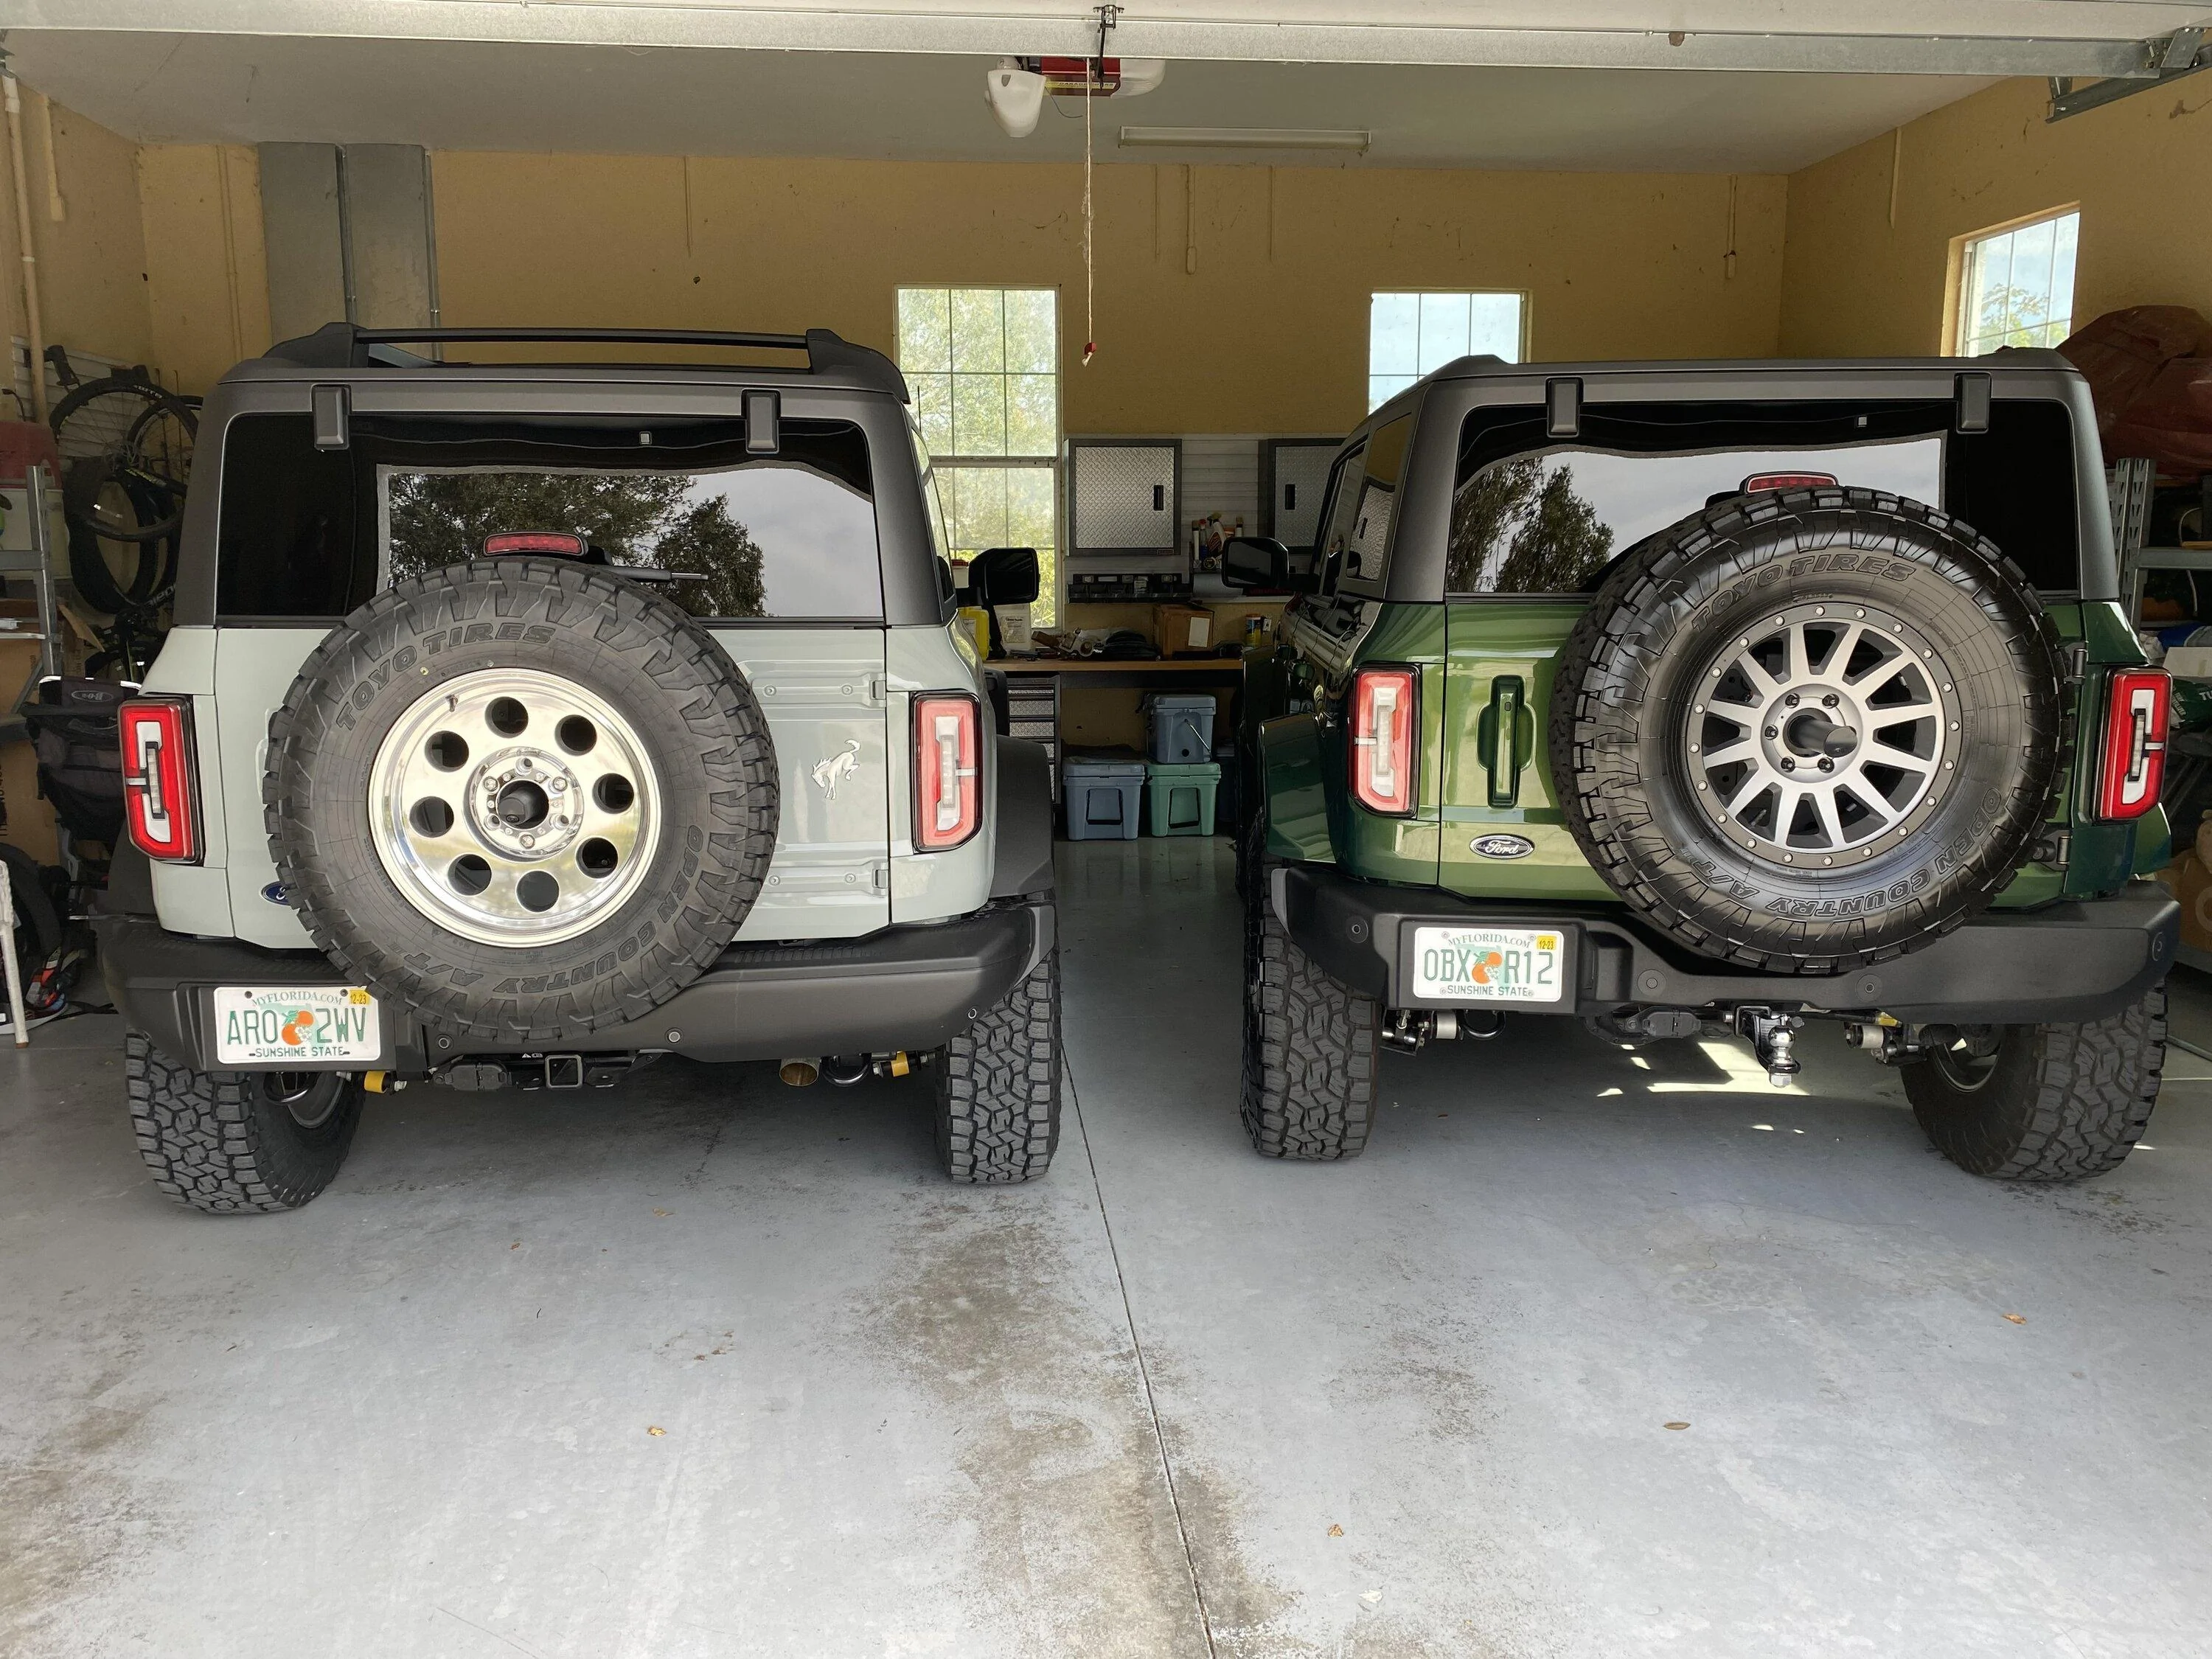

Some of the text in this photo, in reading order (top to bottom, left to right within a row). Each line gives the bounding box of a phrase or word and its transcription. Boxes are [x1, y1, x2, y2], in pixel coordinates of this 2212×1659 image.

[1691, 554, 1917, 633] TOYO TIRES
[335, 622, 555, 731] TOYO TIRES
[1484, 839, 1520, 854] Ford
[1935, 787, 2002, 875] OPEN
[657, 824, 703, 923] OPEN
[1692, 860, 1760, 899] A/T
[1765, 869, 1931, 917] COUNTRY
[492, 921, 657, 994] COUNTRY
[1448, 933, 1531, 949] MYFLORIDA.COM
[1539, 940, 1554, 950] 12-23
[404, 952, 484, 984] A/T
[1505, 950, 1553, 984] R12
[251, 990, 343, 1006] MYFLORIDA.COM
[349, 994, 367, 1005] 12-23
[1447, 984, 1528, 996] SUNSHINE STATE
[315, 1007, 366, 1043] 2WV
[255, 1046, 344, 1057] SUNSHINE STATE
